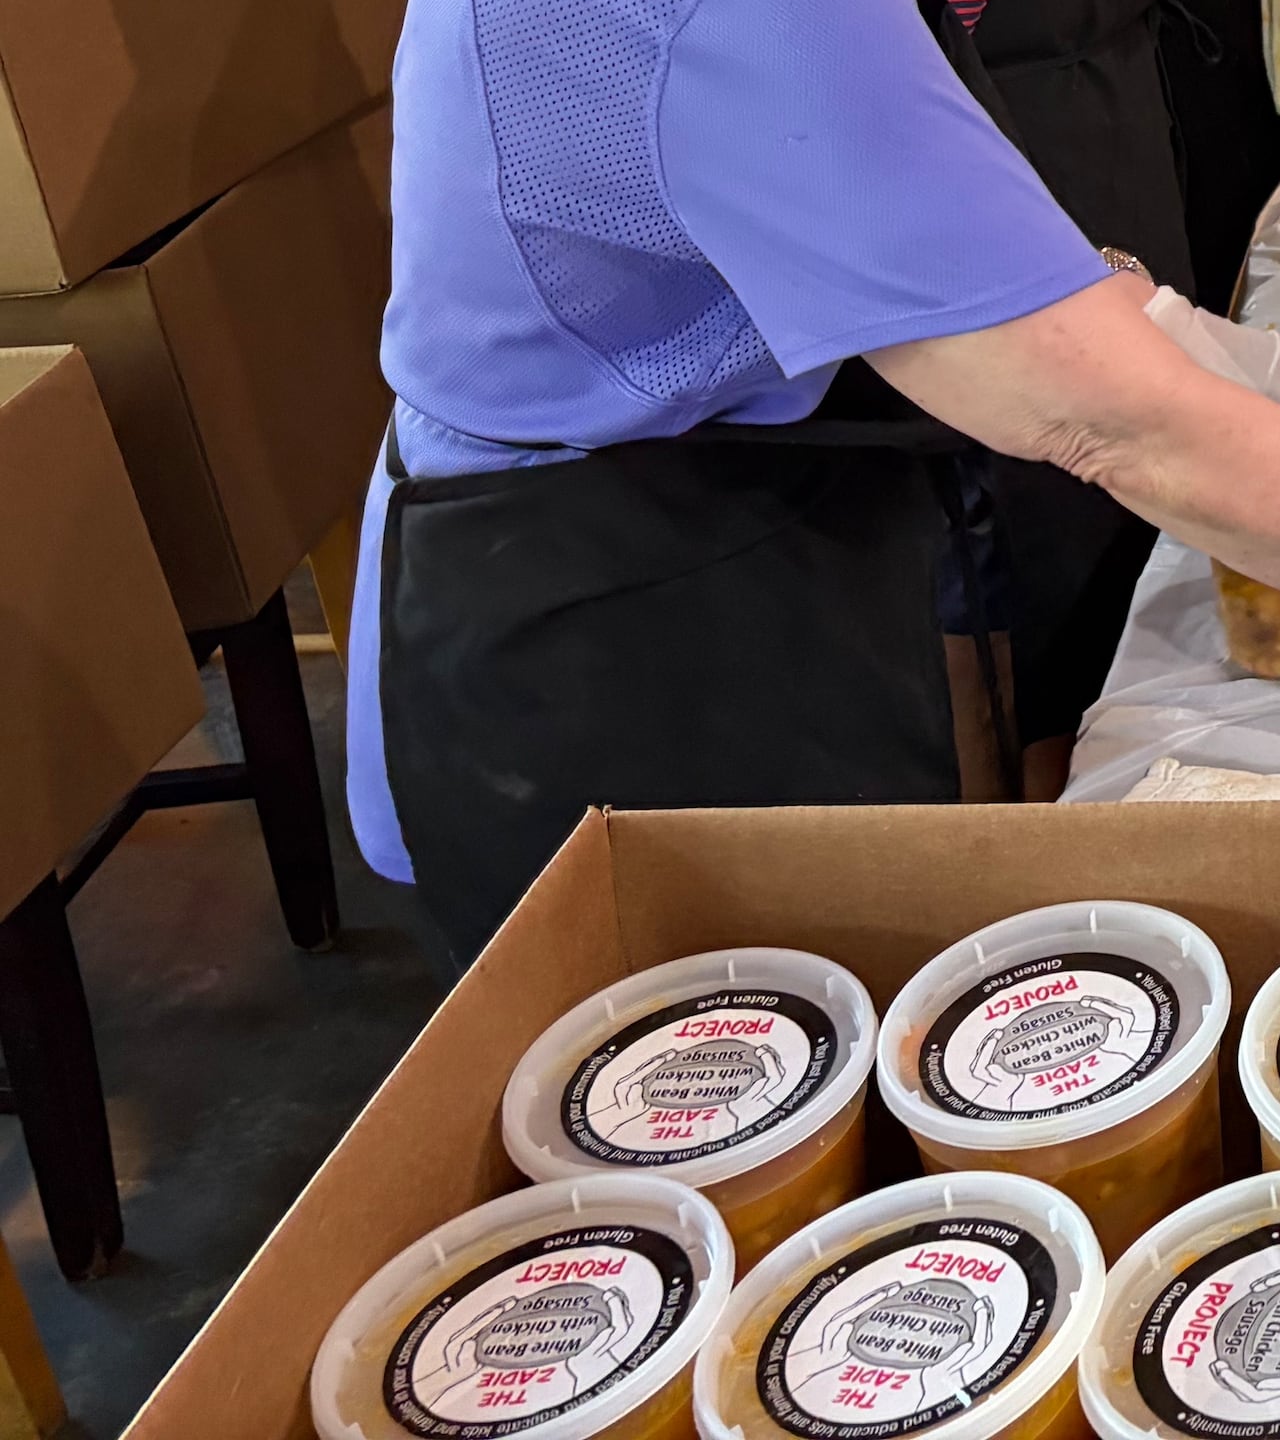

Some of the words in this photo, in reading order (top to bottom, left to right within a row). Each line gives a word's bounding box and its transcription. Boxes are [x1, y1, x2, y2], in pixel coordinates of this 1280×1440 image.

[1013, 959, 1063, 979] Gluten
[982, 973, 1013, 993] Free
[697, 995, 732, 1009] Free
[732, 996, 780, 1008] Gluten
[983, 975, 1079, 1021] PROJECT
[674, 1017, 776, 1038] PROJECT
[1011, 1006, 1075, 1035] Sausage
[1062, 1016, 1098, 1035] with
[1001, 1029, 1061, 1056] Chicken
[1054, 1032, 1101, 1056] White
[682, 1049, 748, 1062] Sausage
[1012, 1050, 1052, 1070] Bean
[655, 1069, 716, 1081] Chicken
[717, 1068, 754, 1079] with
[1031, 1054, 1101, 1087] ZADIE
[650, 1087, 691, 1099] Bean
[694, 1084, 740, 1099] White
[1051, 1074, 1097, 1097] THE
[647, 1108, 720, 1123] ZADIE
[649, 1126, 695, 1140] THE
[939, 1222, 974, 1235] Free
[975, 1223, 1020, 1247] Gluten
[543, 1233, 580, 1250] Free
[515, 1255, 628, 1284] PROJECT
[904, 1248, 1007, 1283] PROJECT
[523, 1294, 593, 1310] Sausage
[903, 1289, 966, 1313] Sausage
[1155, 1280, 1189, 1324] Gluten
[491, 1319, 557, 1335] Chicken
[557, 1314, 599, 1329] with
[869, 1309, 928, 1331] Chicken
[930, 1320, 965, 1338] with
[1169, 1281, 1234, 1369] PROJECT
[1224, 1299, 1266, 1355] Sausage
[483, 1341, 529, 1356] Bean
[531, 1337, 583, 1354] White
[856, 1333, 894, 1354] Bean
[1141, 1323, 1164, 1355] Free
[895, 1338, 944, 1361] White
[477, 1368, 557, 1388] ZADIE
[838, 1364, 910, 1390] ZADIE
[477, 1390, 528, 1408] THE
[832, 1387, 878, 1408] THE
